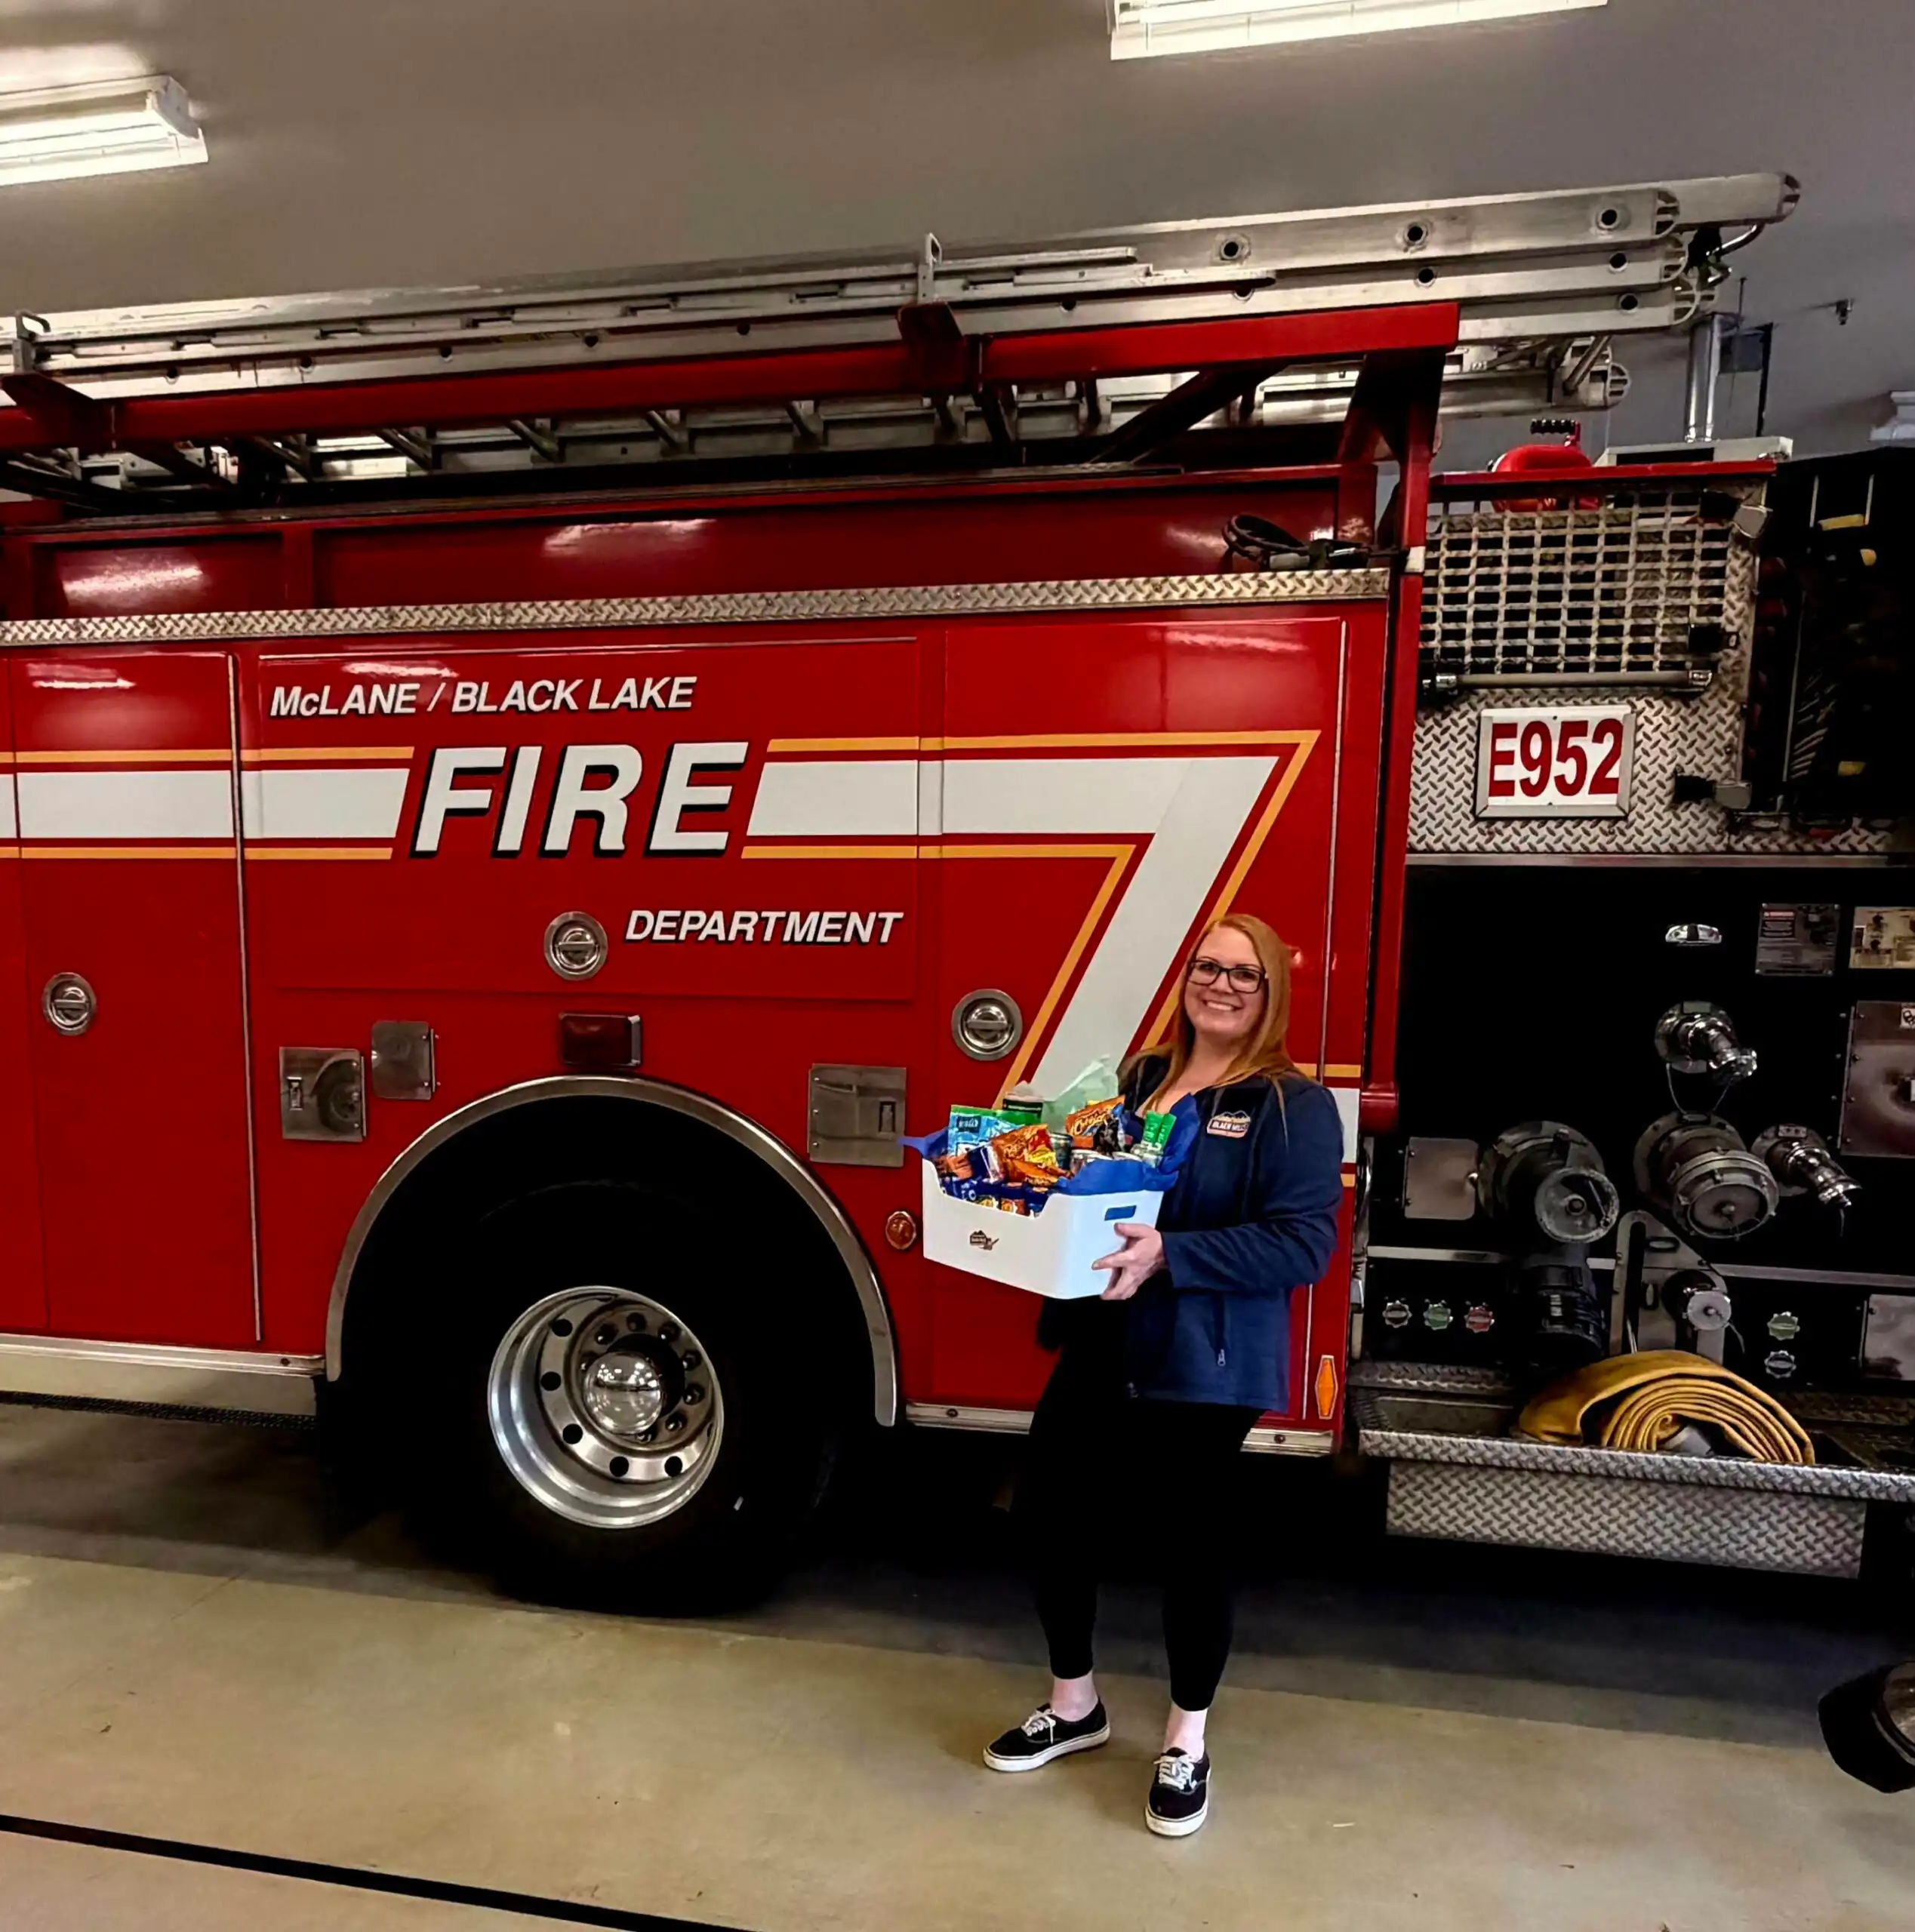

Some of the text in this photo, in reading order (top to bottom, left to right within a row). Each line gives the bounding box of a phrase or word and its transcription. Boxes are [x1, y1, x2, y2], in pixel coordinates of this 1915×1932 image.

[270, 676, 697, 716] McLANE / BLACK LAKE
[1489, 718, 1624, 797] E952
[412, 742, 749, 855] FIRE
[625, 910, 904, 945] DEPARTMENT
